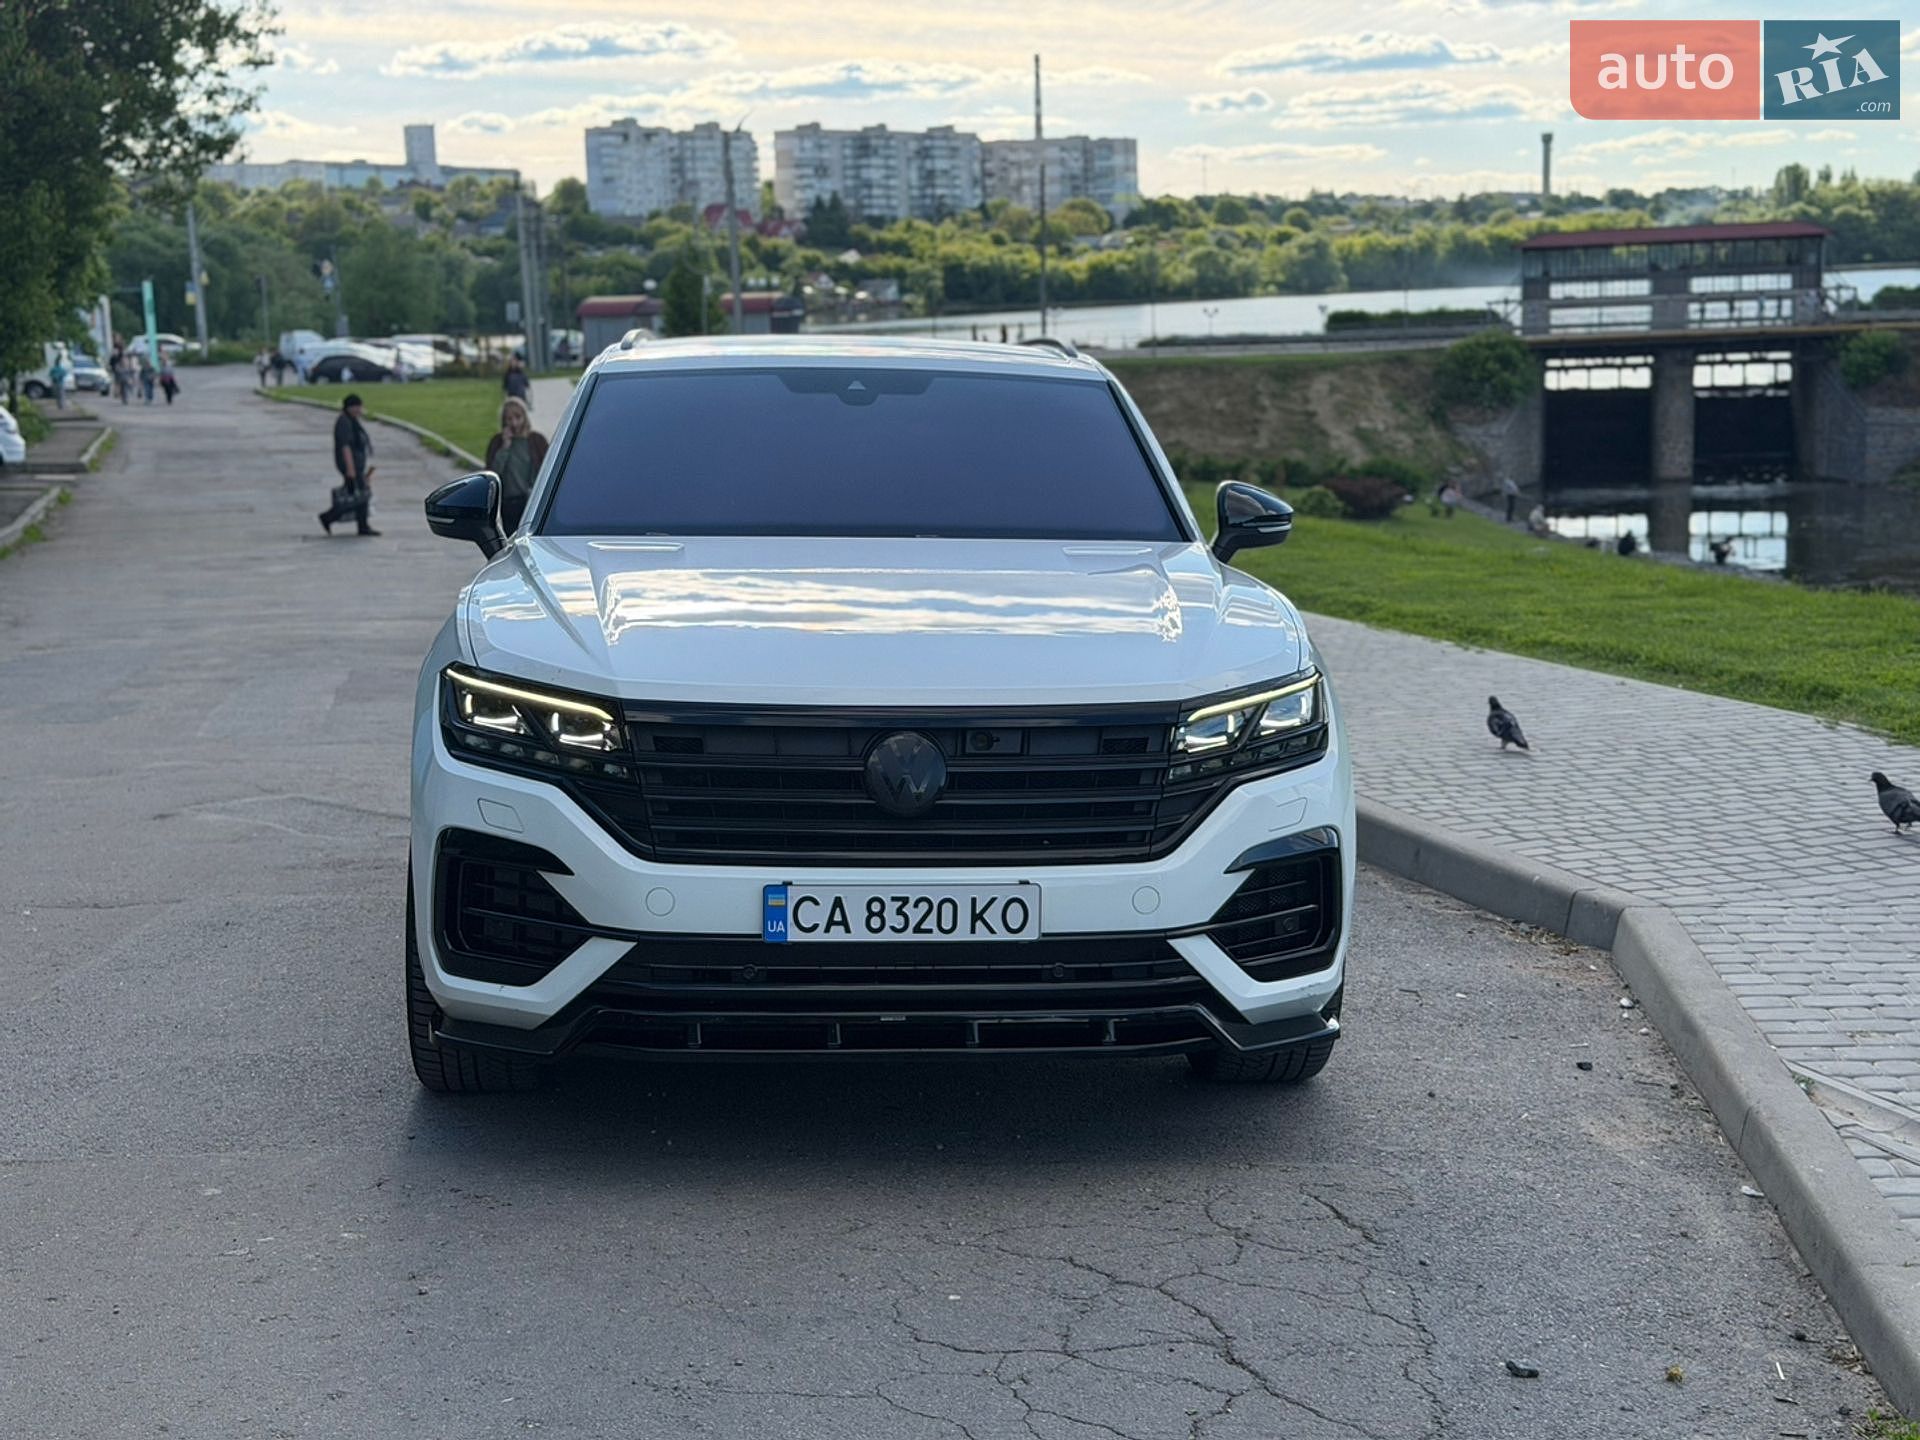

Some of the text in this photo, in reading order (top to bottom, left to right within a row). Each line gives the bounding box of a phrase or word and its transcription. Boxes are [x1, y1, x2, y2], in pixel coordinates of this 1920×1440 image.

[767, 920, 786, 933] UA
[792, 895, 1029, 935] CA 8320 KO
